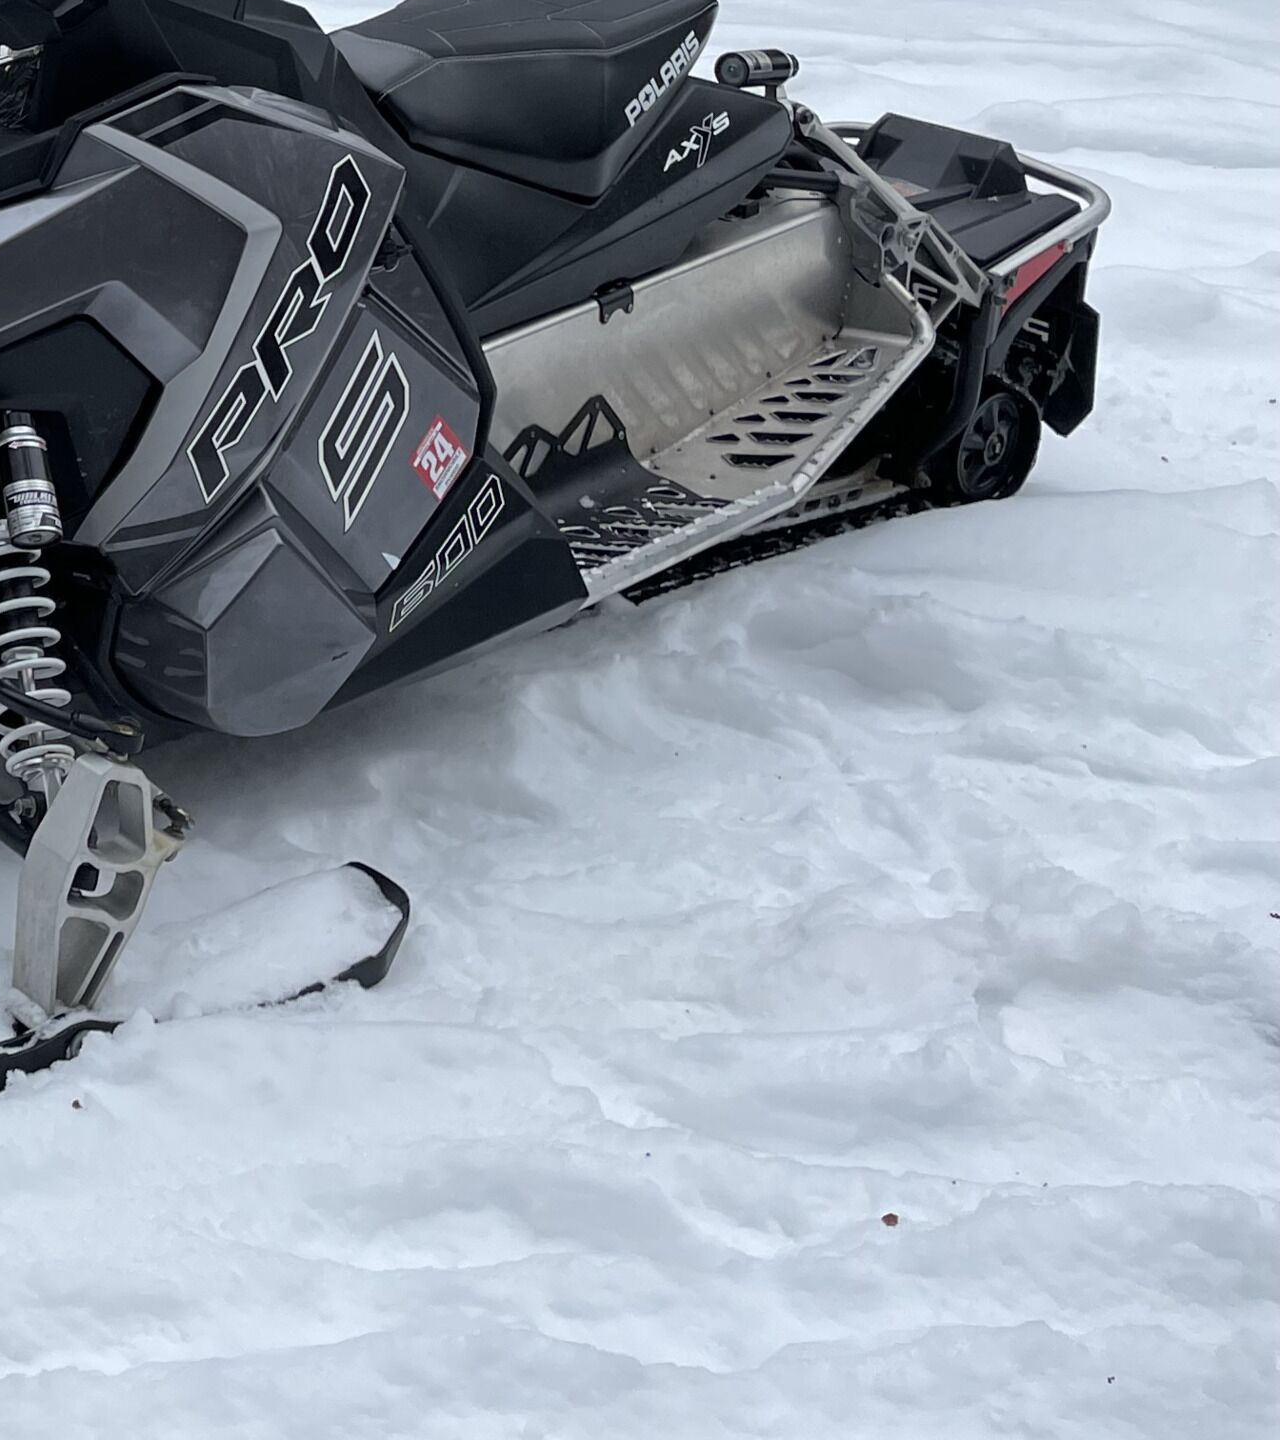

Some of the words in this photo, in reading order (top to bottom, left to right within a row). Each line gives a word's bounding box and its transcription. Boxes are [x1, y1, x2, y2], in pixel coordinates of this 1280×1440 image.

[623, 29, 701, 128] POLARIS
[663, 111, 731, 173] AXYS
[186, 154, 372, 505] PRO
[420, 431, 455, 483] 24
